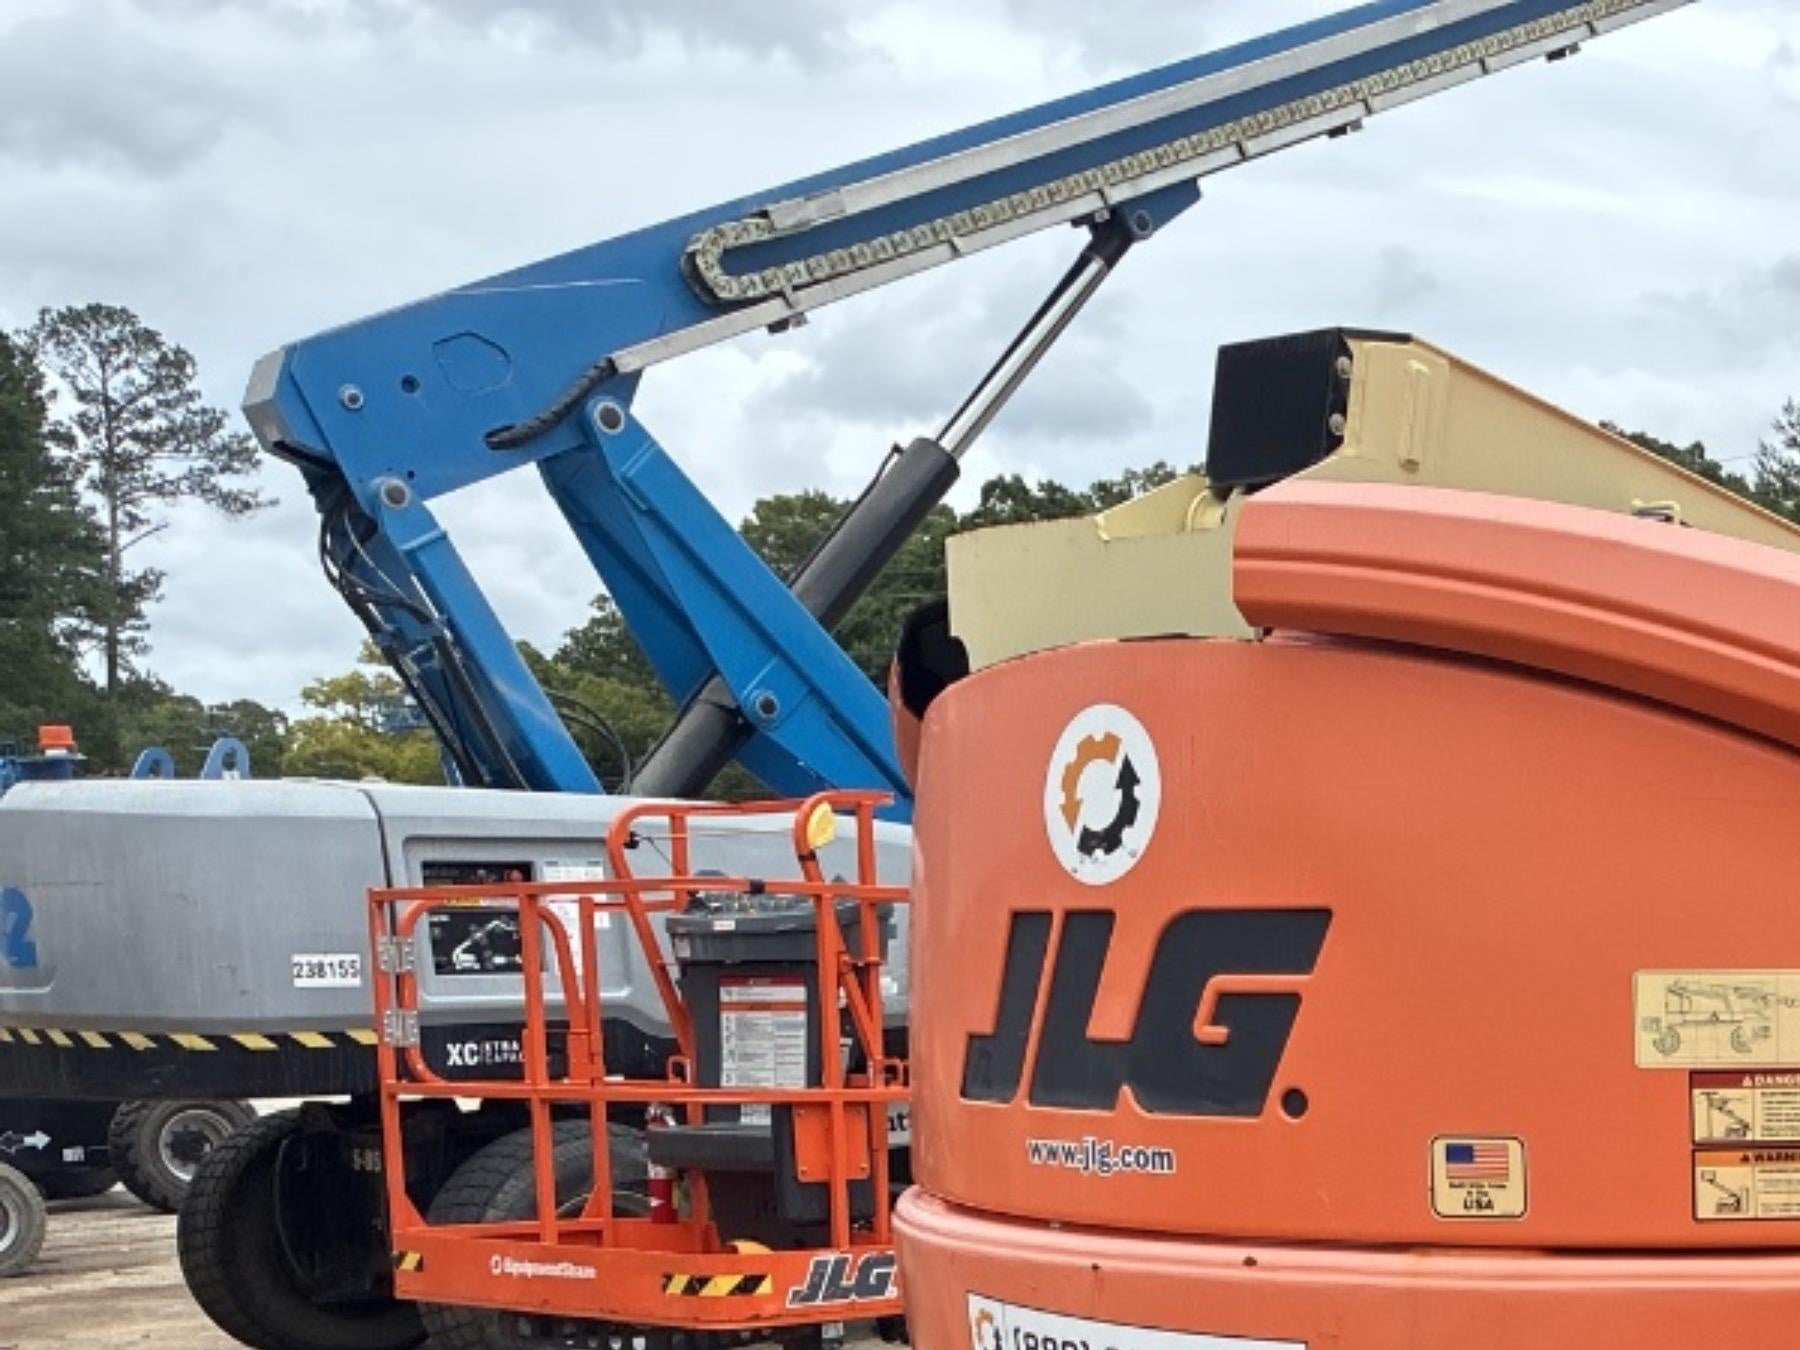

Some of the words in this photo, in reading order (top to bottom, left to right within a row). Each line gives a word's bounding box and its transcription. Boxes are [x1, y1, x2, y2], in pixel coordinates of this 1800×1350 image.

[293, 959, 359, 978] 238155
[446, 1043, 478, 1066] XC
[1027, 1138, 1175, 1172] www.jlg.com
[1463, 1198, 1494, 1210] USA
